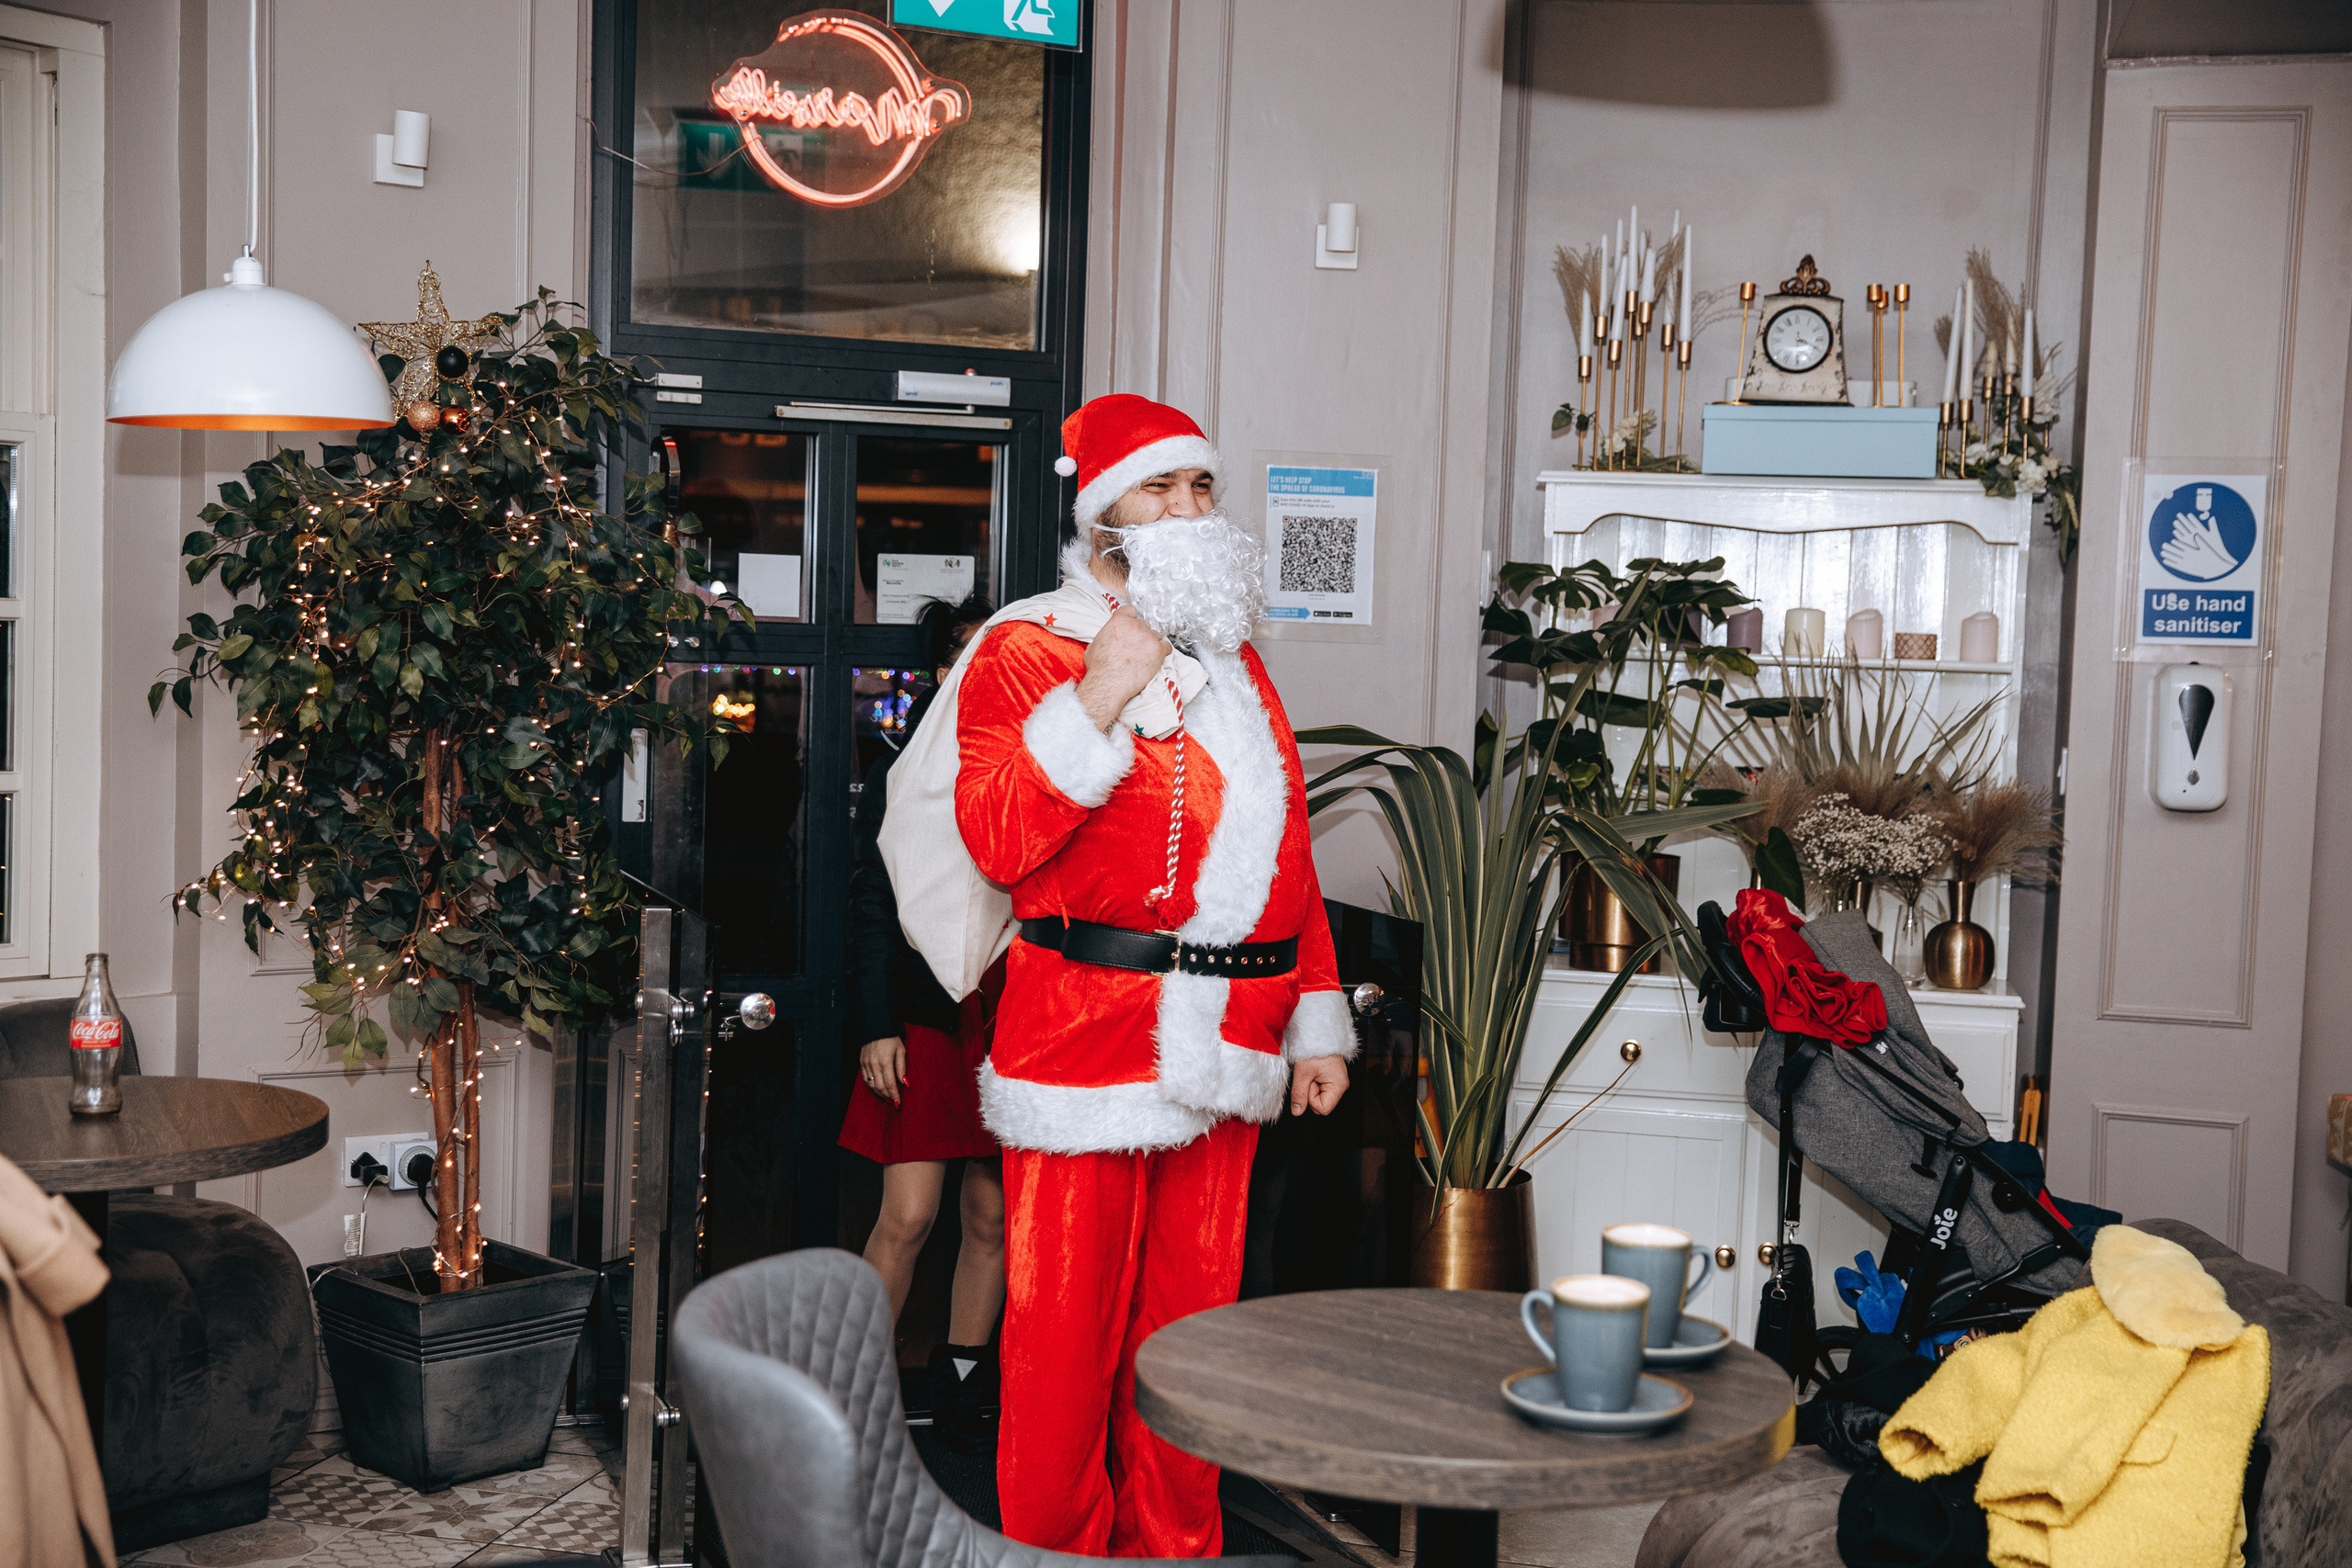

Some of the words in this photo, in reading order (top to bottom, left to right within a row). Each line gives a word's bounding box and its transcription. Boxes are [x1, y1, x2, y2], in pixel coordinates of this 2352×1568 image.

[1270, 476, 1284, 484] LET'S
[1284, 476, 1298, 484] HELP
[1298, 476, 1312, 484] STOP
[1270, 483, 1280, 491] THE
[1280, 484, 1301, 492] SPREAD
[1301, 484, 1308, 492] OF
[1308, 485, 1346, 494] CORONAVIRUS
[2151, 593, 2190, 612] Use
[2195, 594, 2246, 613] hand
[2154, 615, 2243, 634] sanitiser
[73, 1021, 120, 1040] Coca-Cola
[1929, 1207, 1959, 1250] Joie
